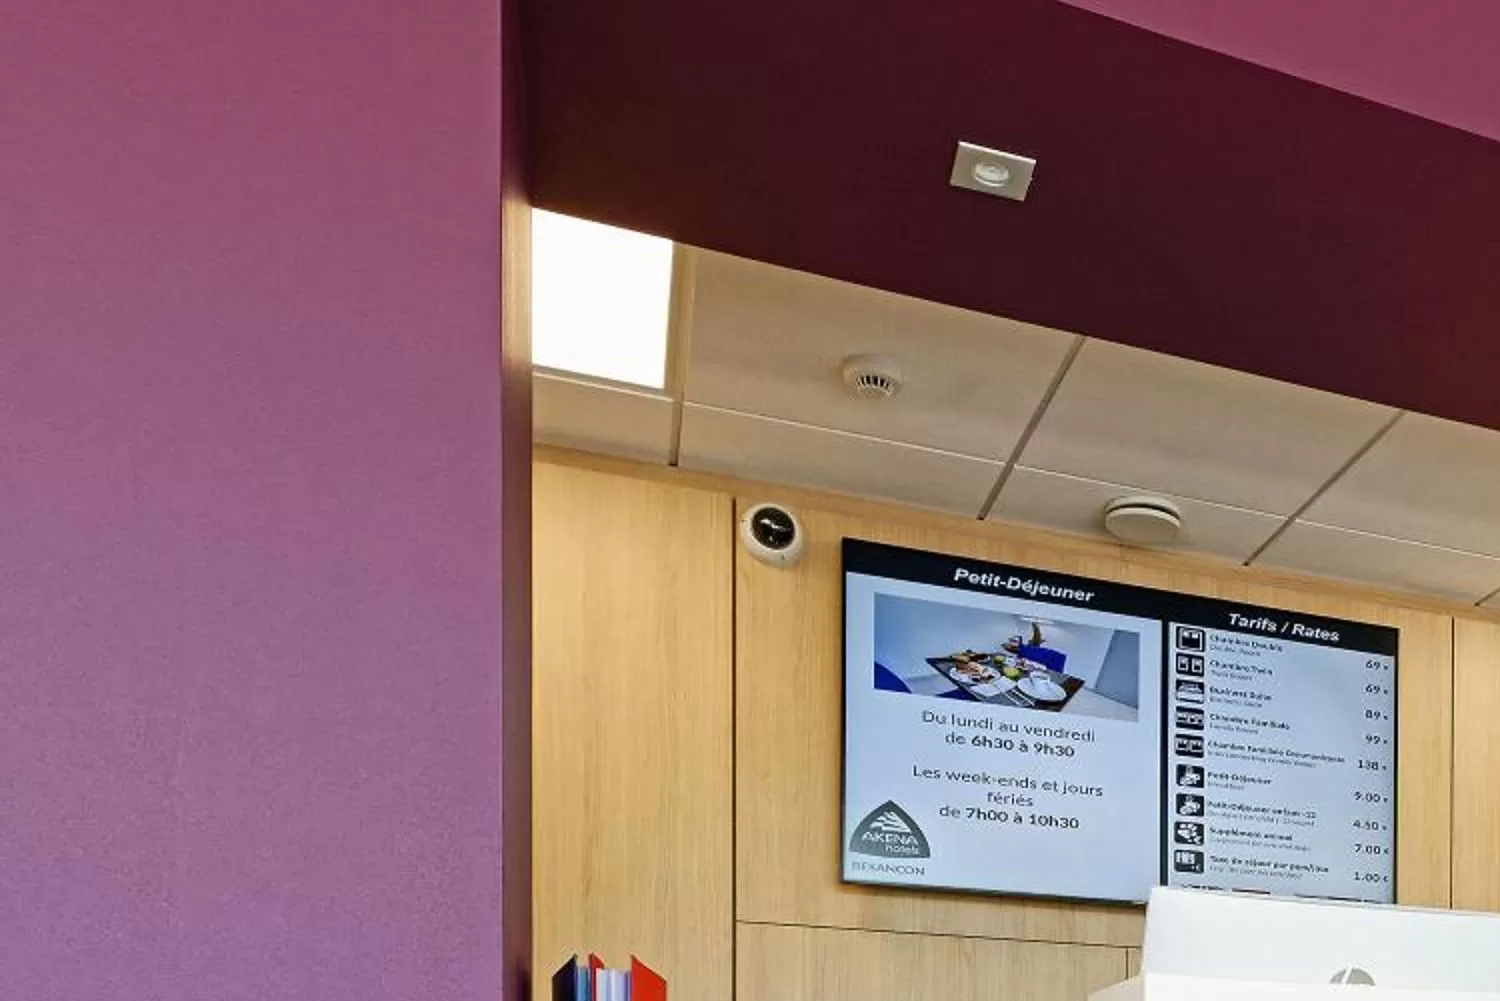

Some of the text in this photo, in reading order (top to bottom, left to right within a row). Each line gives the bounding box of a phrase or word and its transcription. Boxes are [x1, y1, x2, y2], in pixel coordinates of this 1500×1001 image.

[953, 567, 1096, 602] Petit-Déjeuner
[1228, 612, 1278, 633] Tarifs
[1292, 622, 1341, 642] Rates
[1366, 660, 1380, 670] 69
[1366, 684, 1380, 694] 69
[922, 710, 1096, 742] Du lundi au vendredi
[946, 731, 1074, 758] de 6h30 à 9h30
[913, 764, 1104, 798] Les week-ends et jours
[987, 790, 1034, 807] fériés
[940, 805, 1079, 830] de 7h00 à 10h30
[862, 832, 919, 846] AKENA
